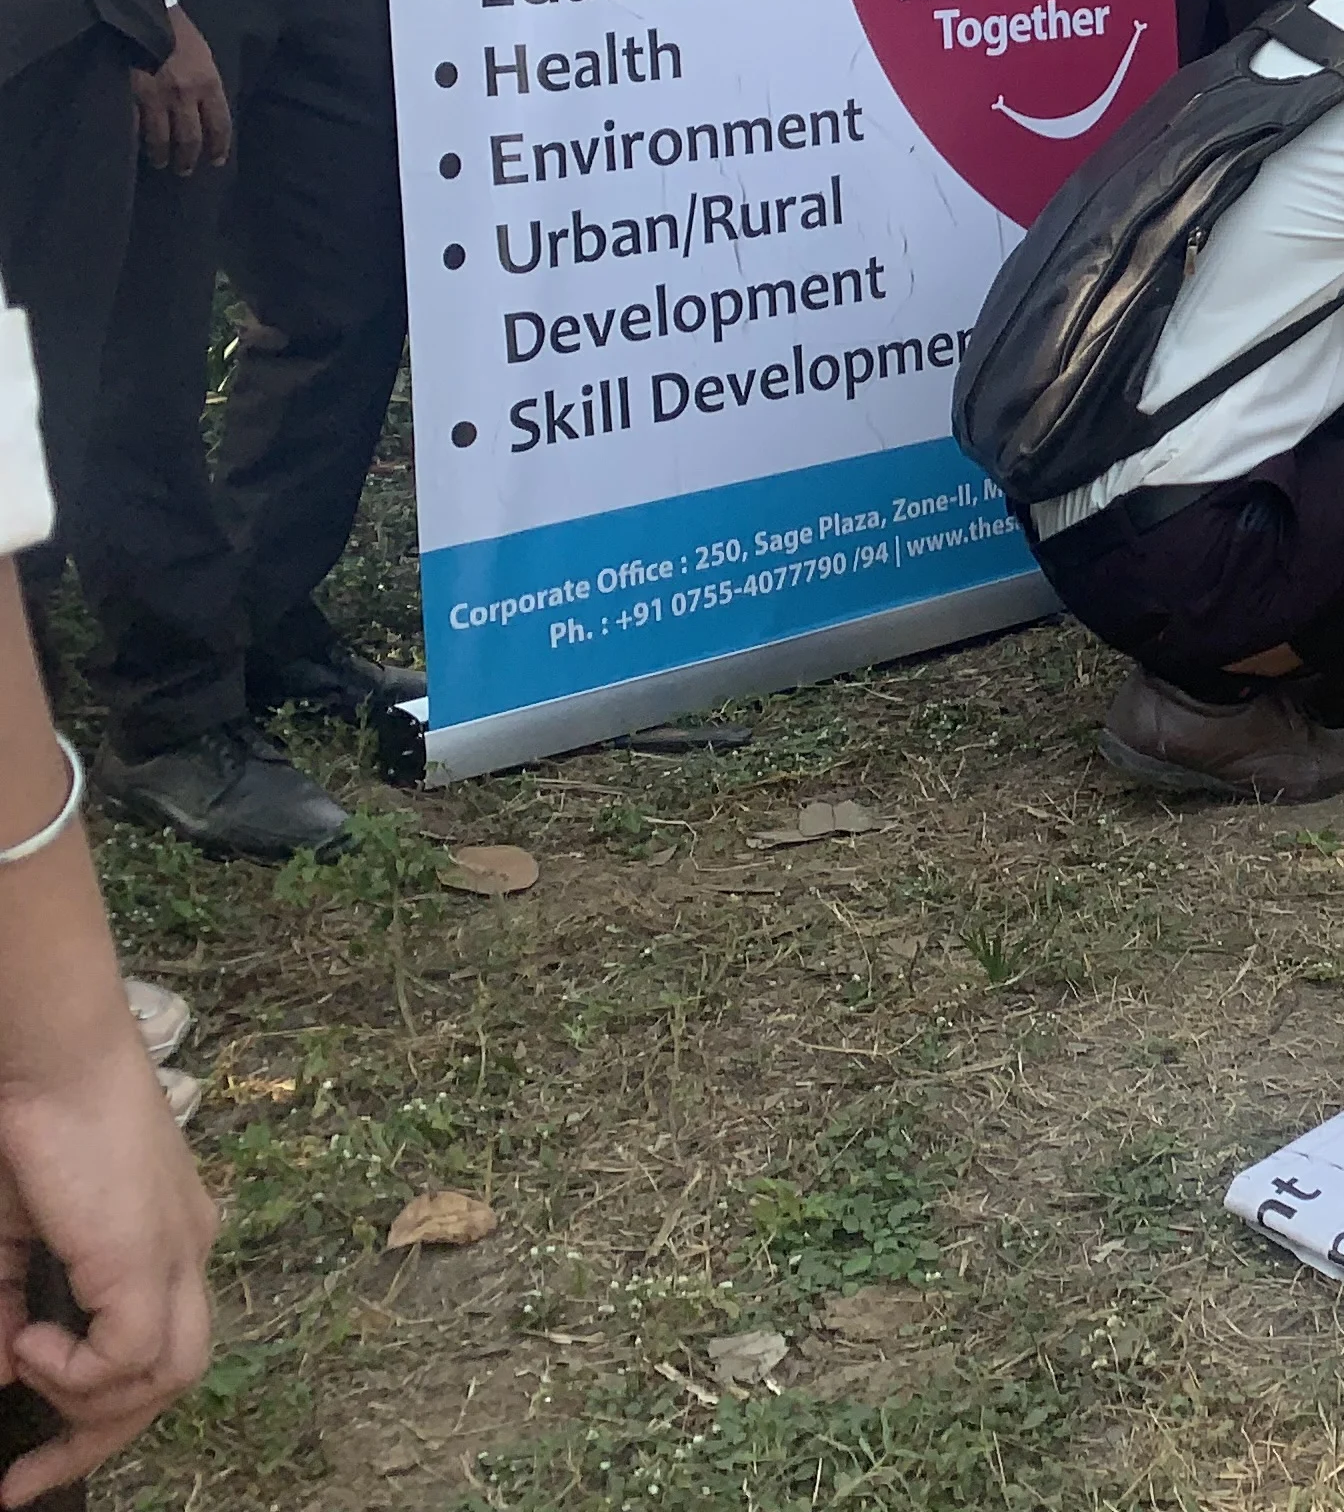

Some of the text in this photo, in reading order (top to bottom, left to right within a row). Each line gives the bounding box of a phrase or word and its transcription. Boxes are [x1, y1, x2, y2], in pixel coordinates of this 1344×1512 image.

[484, 28, 682, 97] Health
[934, 0, 1110, 56] Together
[490, 97, 865, 186] Environment
[495, 175, 844, 275] Urban/Rural
[503, 256, 886, 365] Development
[510, 376, 632, 454] Skill
[450, 578, 591, 631] Corporate
[596, 555, 673, 596] Office
[696, 538, 748, 573] 250,
[755, 524, 813, 558] Sage
[818, 508, 887, 541] Plaza,
[892, 483, 978, 522] Zone-II,
[549, 616, 593, 649] Ph.
[615, 599, 664, 632] +91
[672, 553, 848, 619] 0755-4077790
